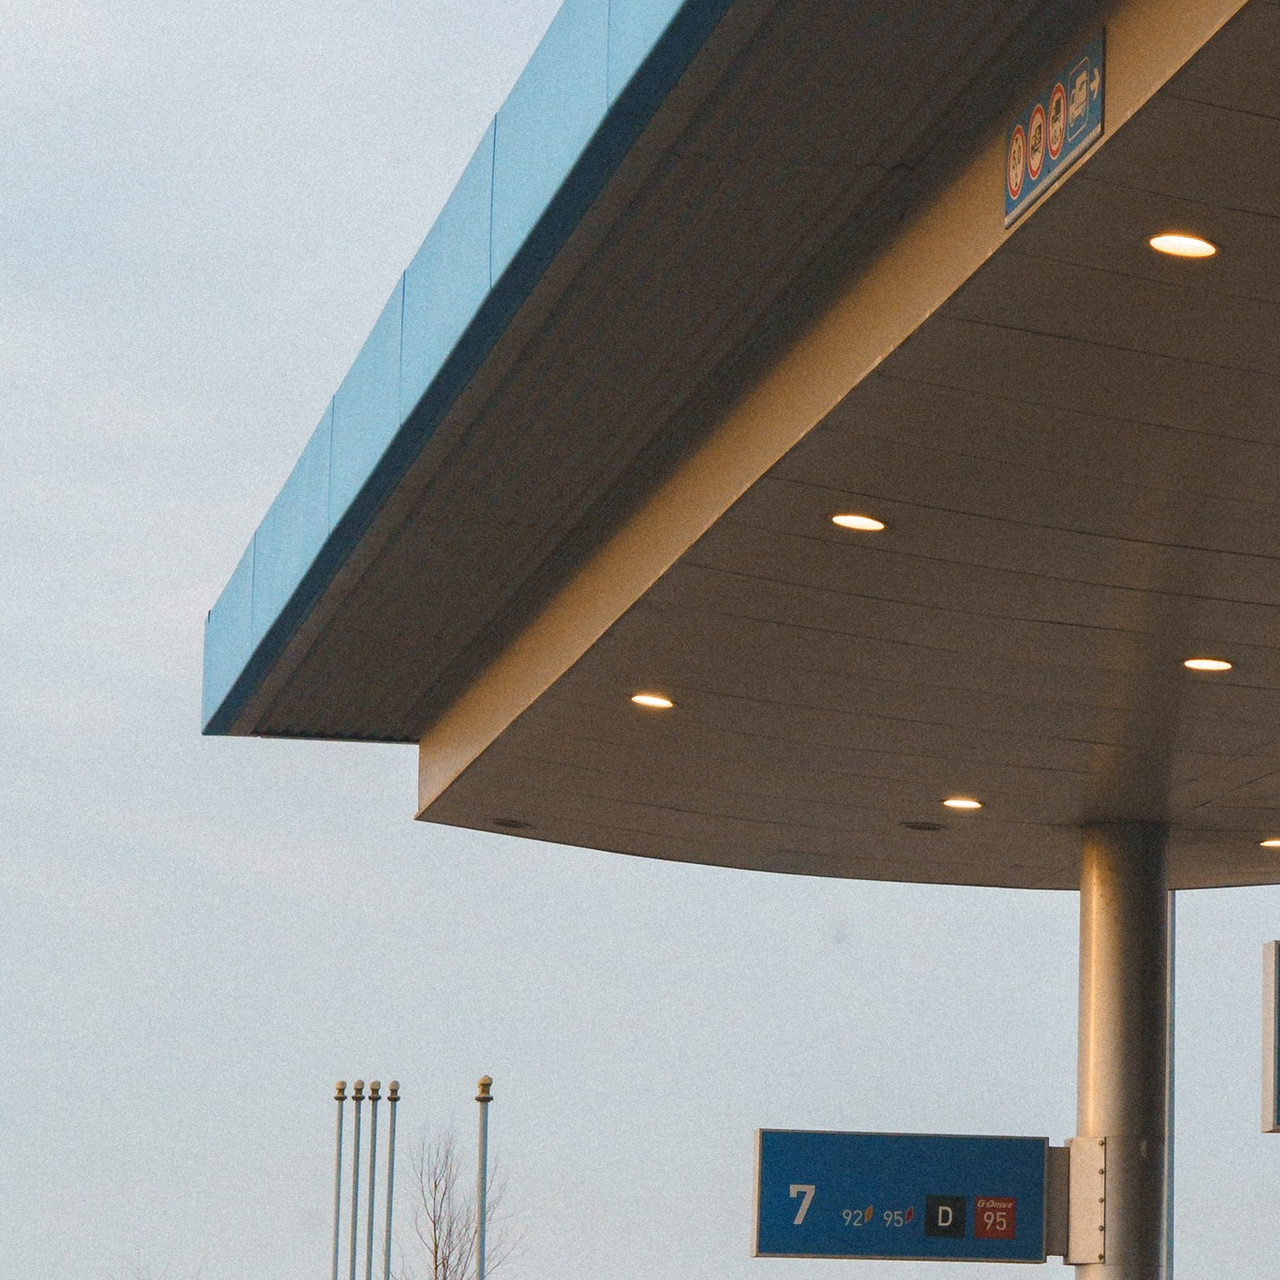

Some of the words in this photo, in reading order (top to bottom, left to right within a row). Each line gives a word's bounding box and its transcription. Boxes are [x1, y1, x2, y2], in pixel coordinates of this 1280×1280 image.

[789, 1184, 816, 1225] 7
[842, 1209, 863, 1227] 92
[883, 1210, 904, 1227] 95
[937, 1205, 953, 1227] D
[983, 1211, 1007, 1231] 95
